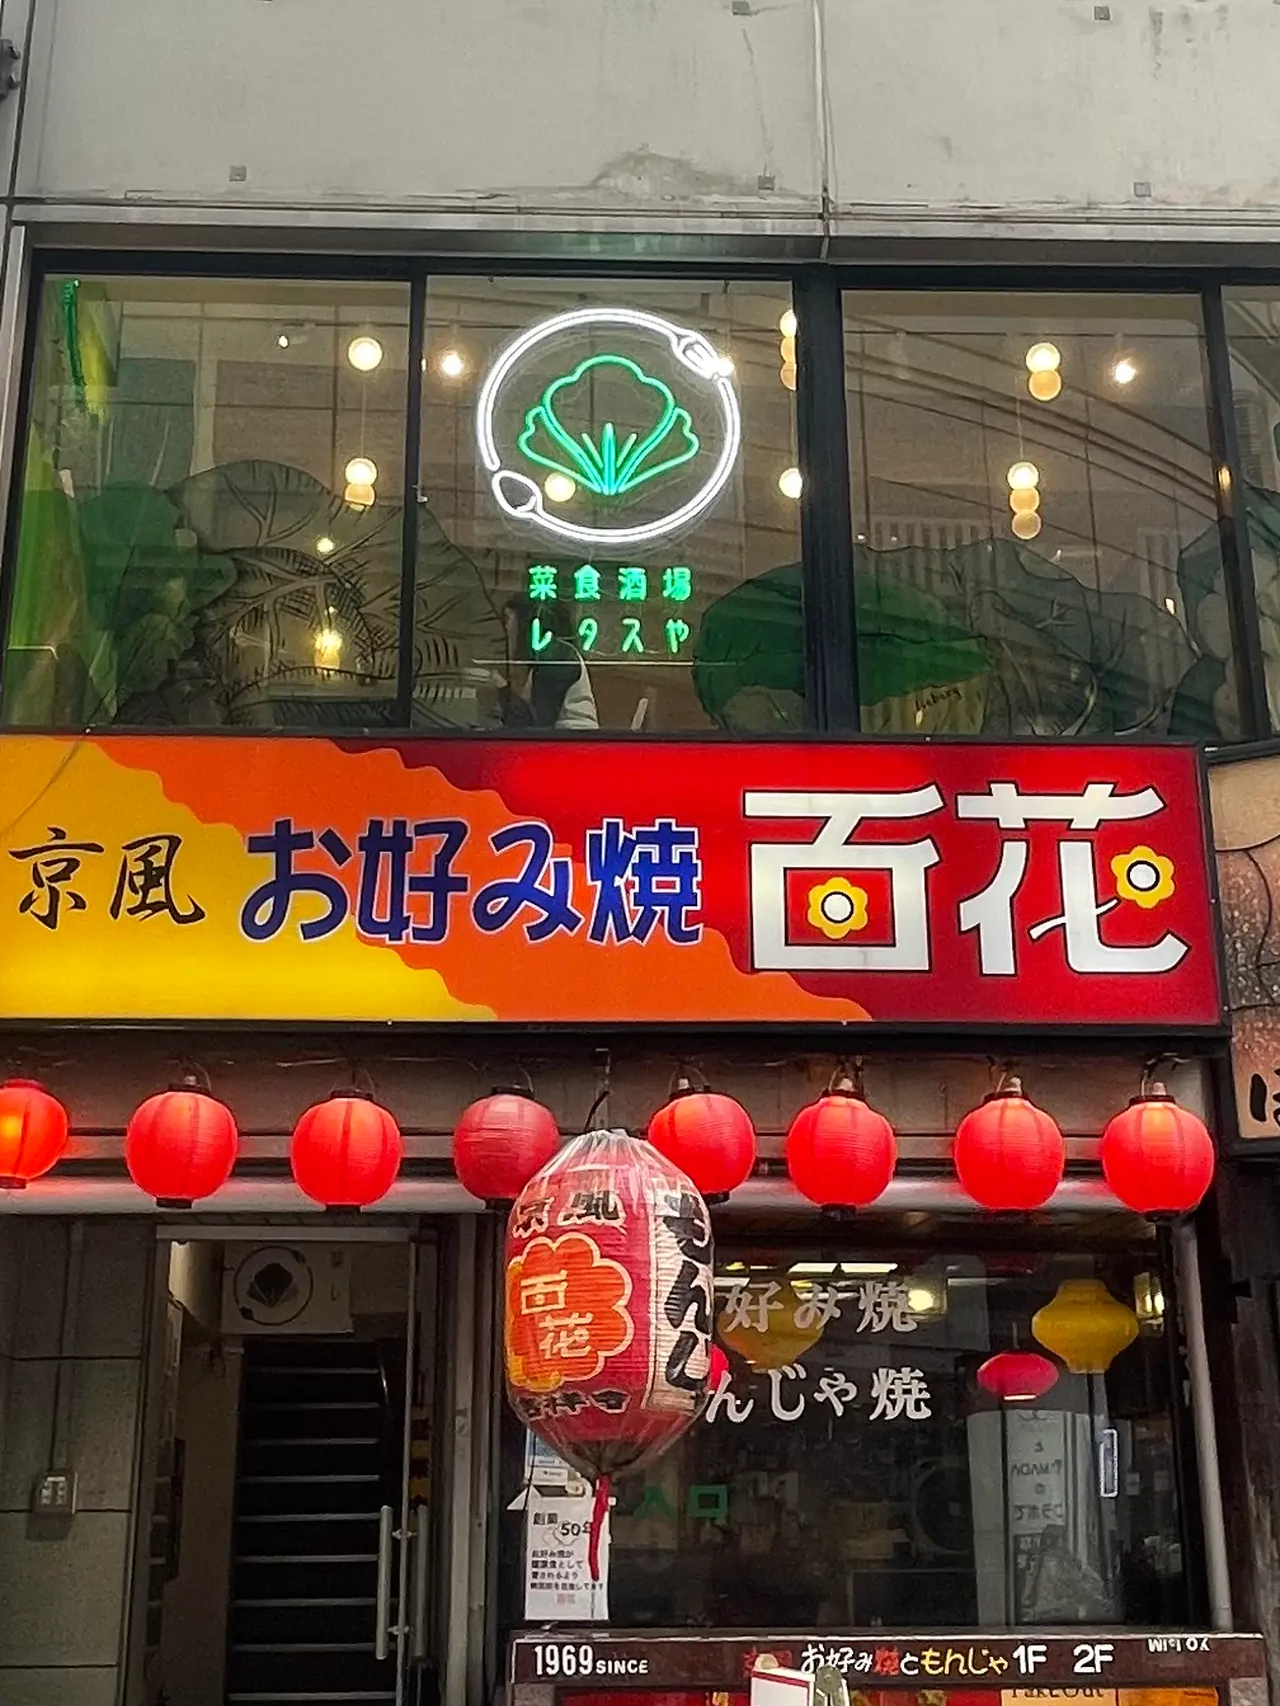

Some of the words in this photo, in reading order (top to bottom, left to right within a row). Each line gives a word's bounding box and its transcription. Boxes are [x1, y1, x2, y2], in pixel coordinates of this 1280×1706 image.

[528, 563, 693, 601] 菜食酒場
[529, 618, 691, 654] レタスや
[7, 826, 207, 932] 京風
[239, 815, 704, 946] お好み焼
[742, 780, 1190, 976] 百花
[534, 1644, 594, 1676] 1969
[595, 1658, 649, 1675] SINCE
[1012, 1644, 1048, 1675] 1F
[1072, 1644, 1114, 1675] 2F
